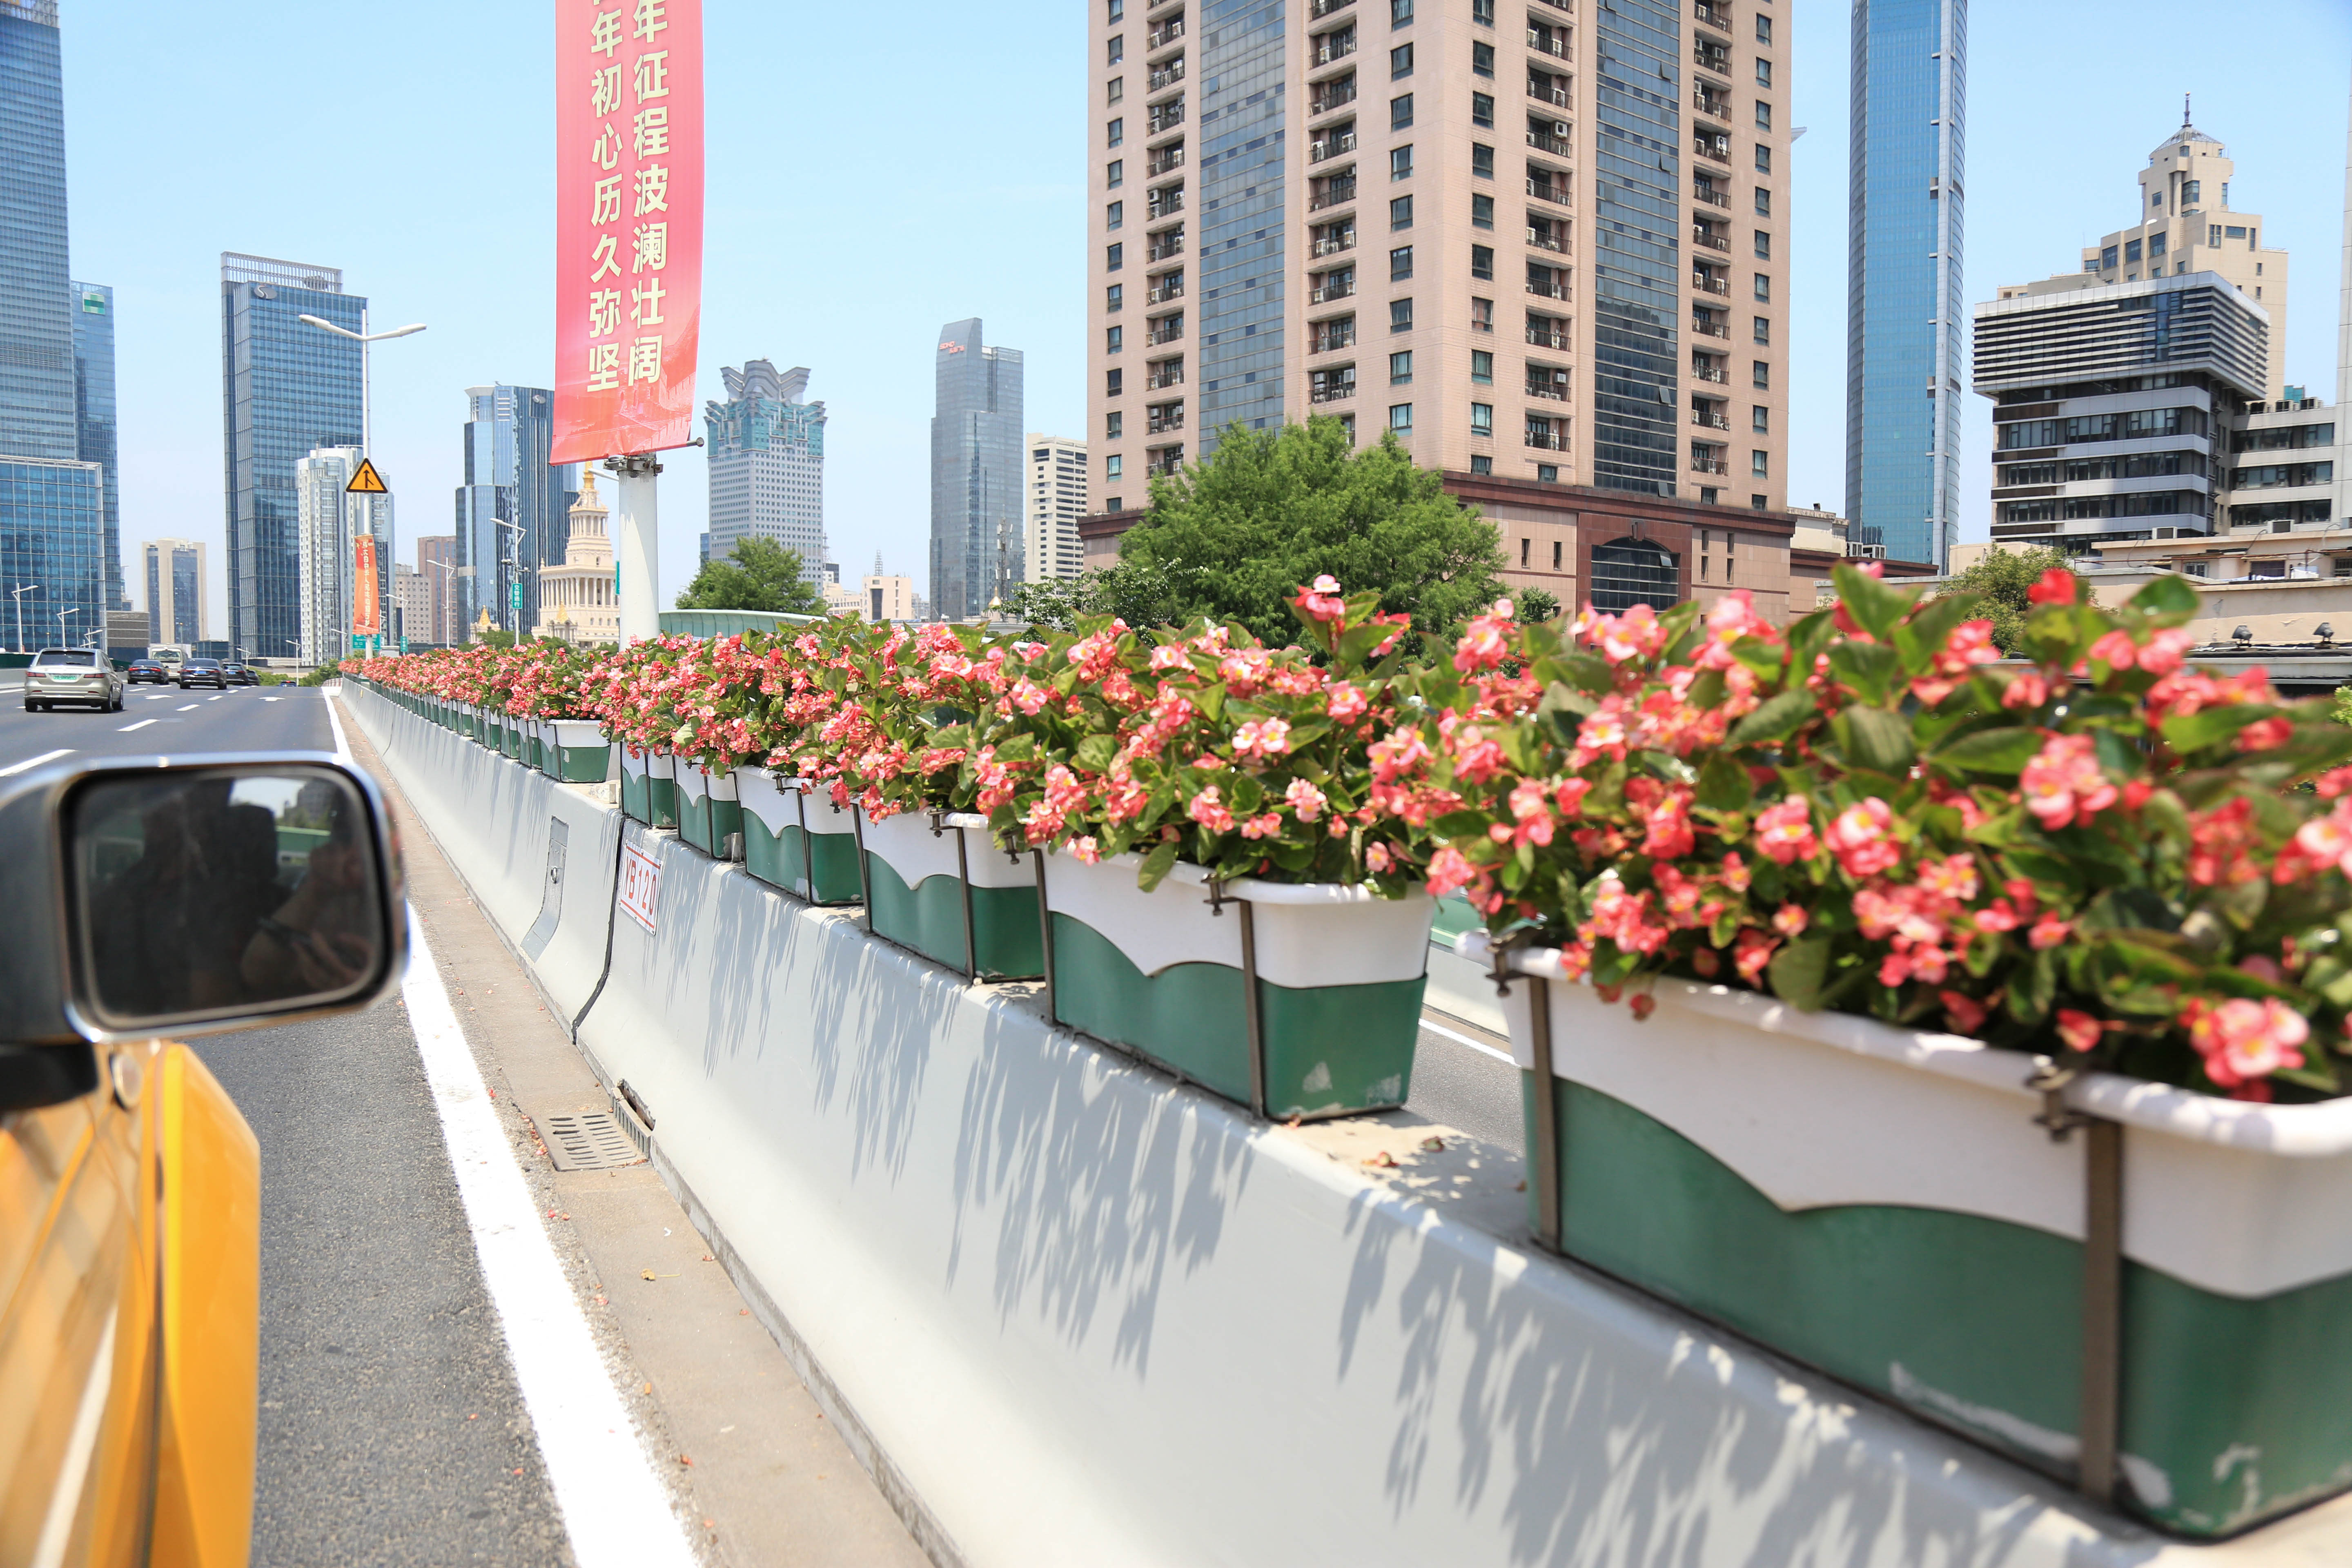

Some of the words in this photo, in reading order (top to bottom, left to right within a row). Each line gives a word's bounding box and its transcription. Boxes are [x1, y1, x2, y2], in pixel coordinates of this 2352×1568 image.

[587, 0, 623, 393] 年初心历久弥坚
[628, 0, 669, 386] 年征程波澜壮阔
[625, 855, 657, 916] YB120
